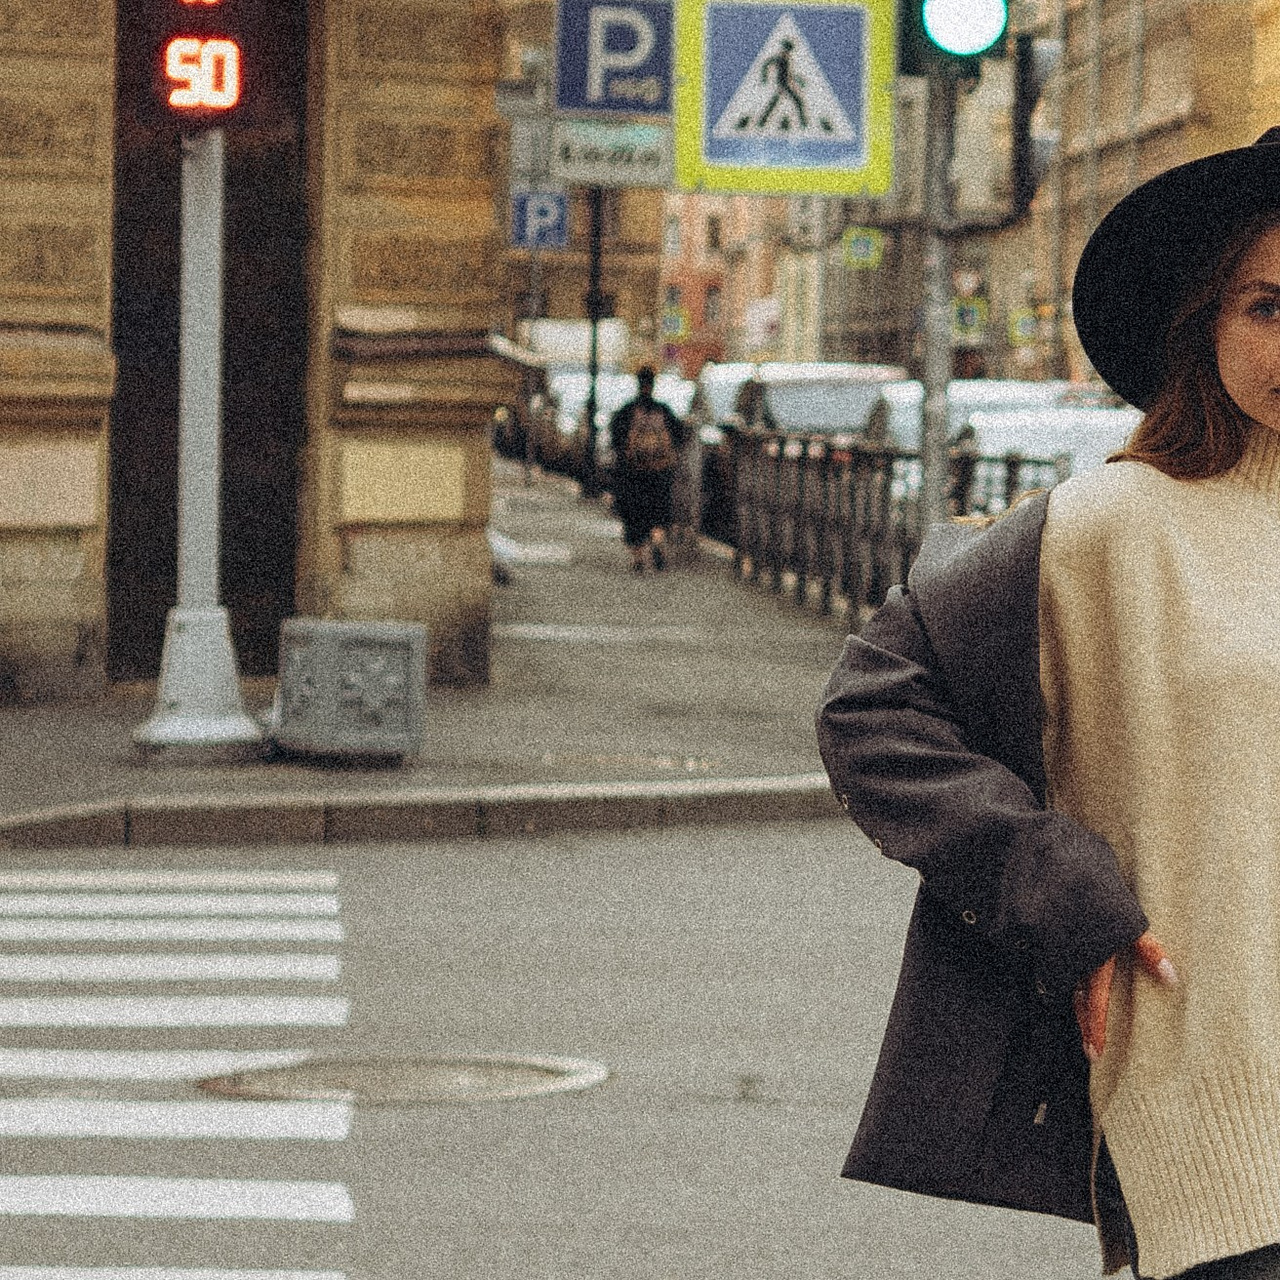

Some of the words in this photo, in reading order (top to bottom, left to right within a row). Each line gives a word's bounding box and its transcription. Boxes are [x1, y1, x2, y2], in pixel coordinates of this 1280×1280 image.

[165, 38, 241, 108] 50
[586, 7, 654, 102] P
[526, 195, 557, 244] P
